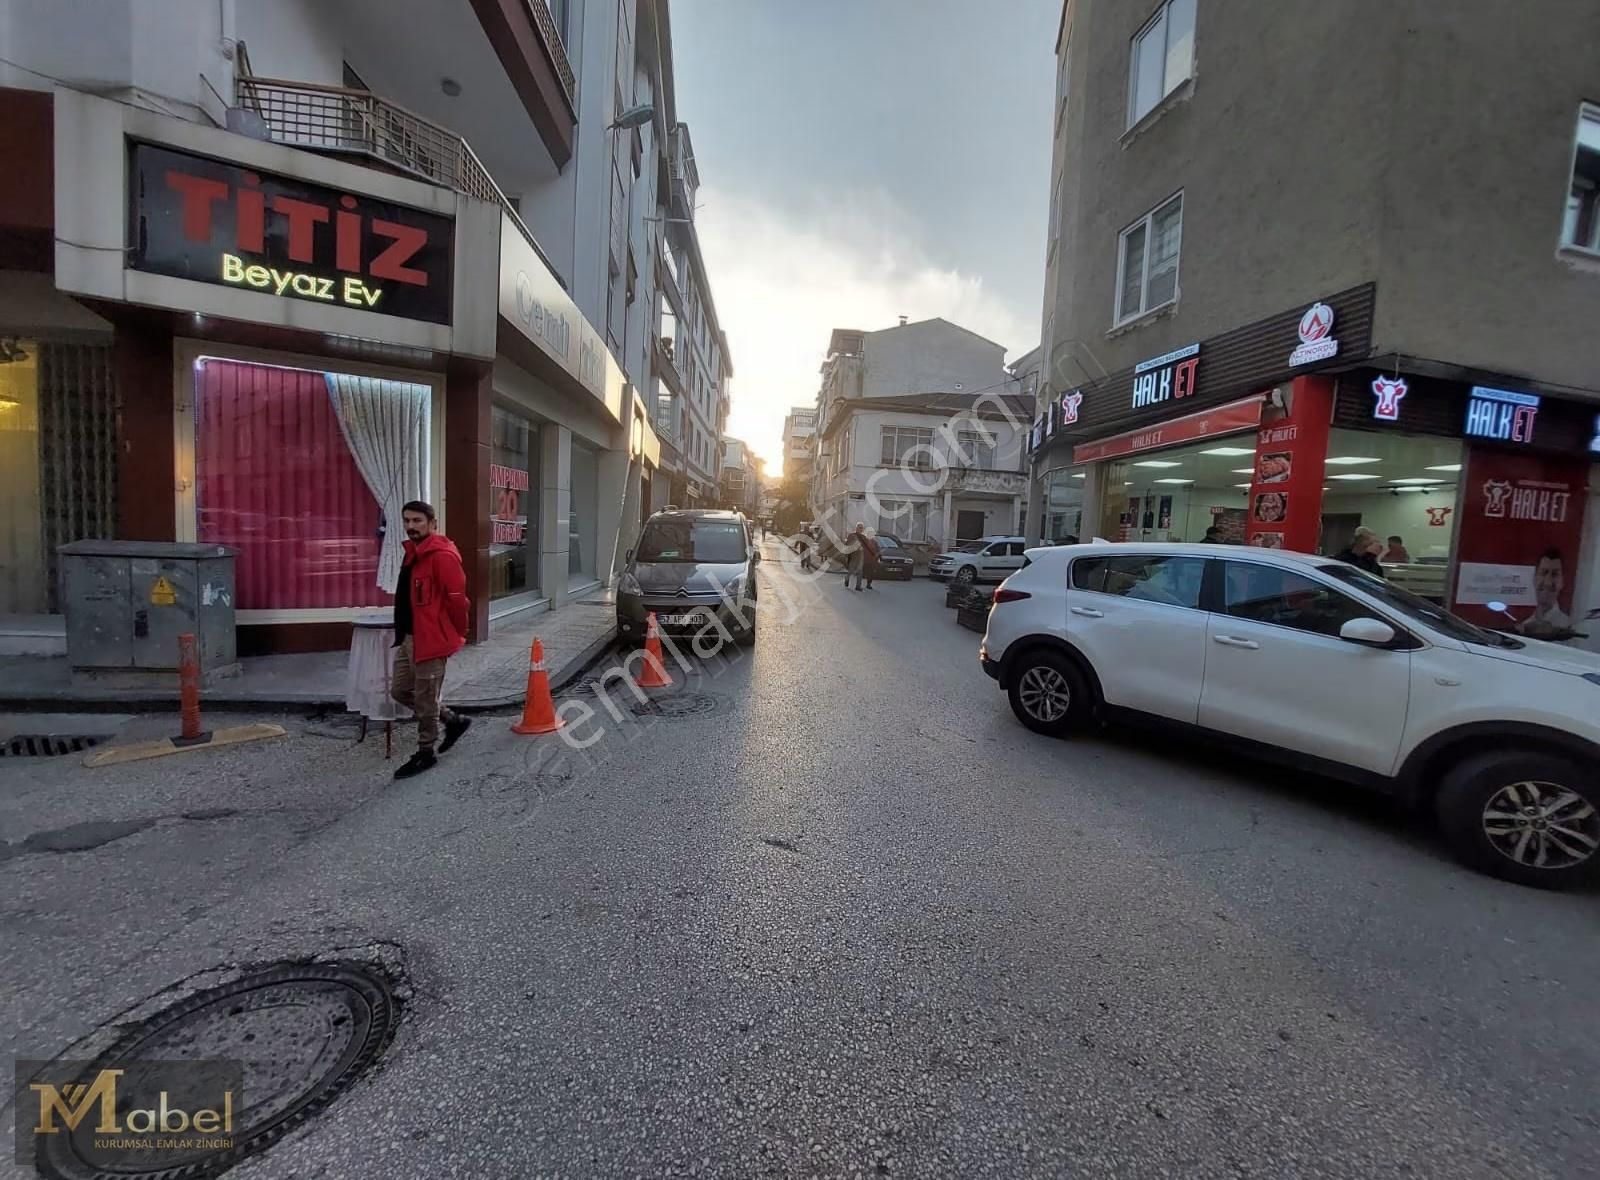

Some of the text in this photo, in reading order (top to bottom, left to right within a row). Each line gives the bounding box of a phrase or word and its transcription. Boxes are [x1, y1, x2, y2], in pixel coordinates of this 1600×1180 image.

[164, 169, 428, 286] TİTİZ
[222, 254, 383, 308] Beyaz Ev
[515, 270, 570, 364] Cemil
[1132, 358, 1200, 408] HALK ET
[1465, 399, 1538, 443] HALK ET
[1510, 488, 1571, 522] HALK ET
